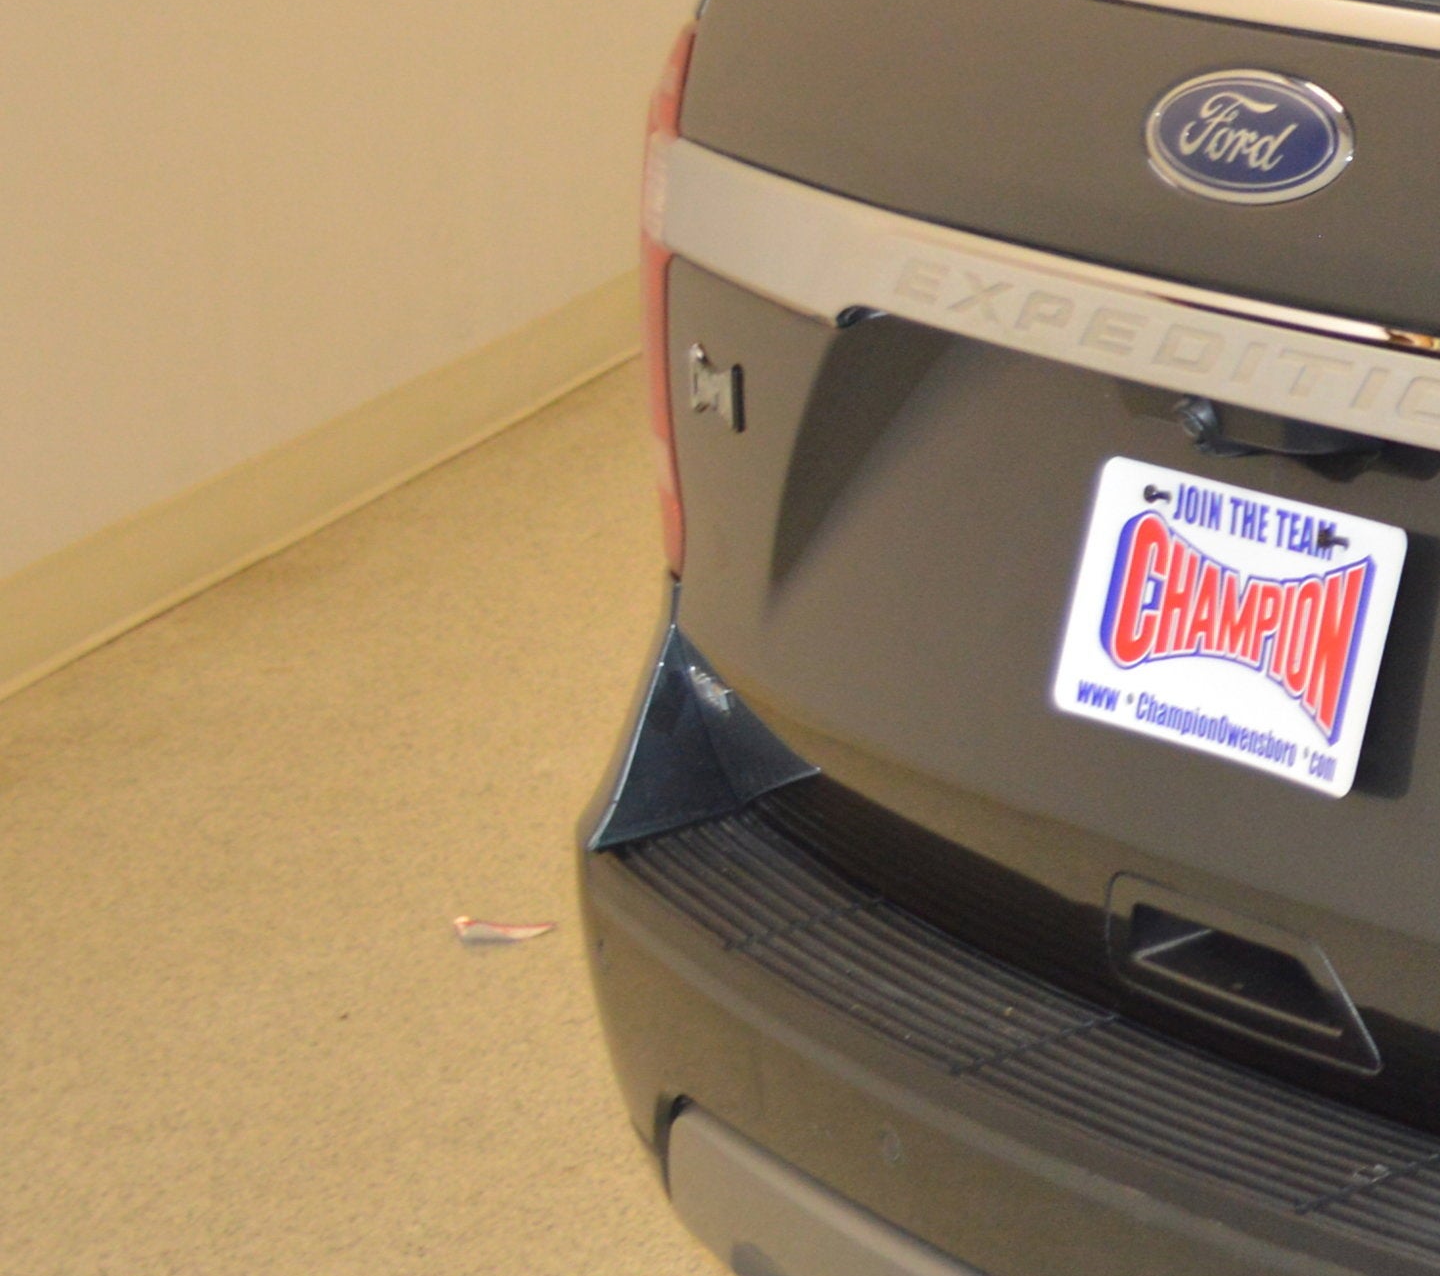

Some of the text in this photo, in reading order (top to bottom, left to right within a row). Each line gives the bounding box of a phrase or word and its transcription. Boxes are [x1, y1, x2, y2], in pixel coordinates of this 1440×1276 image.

[1179, 91, 1299, 172] Ford
[1172, 483, 1224, 531] JOIN
[1229, 496, 1270, 543] THE
[1101, 510, 1377, 746] CHAMPION
